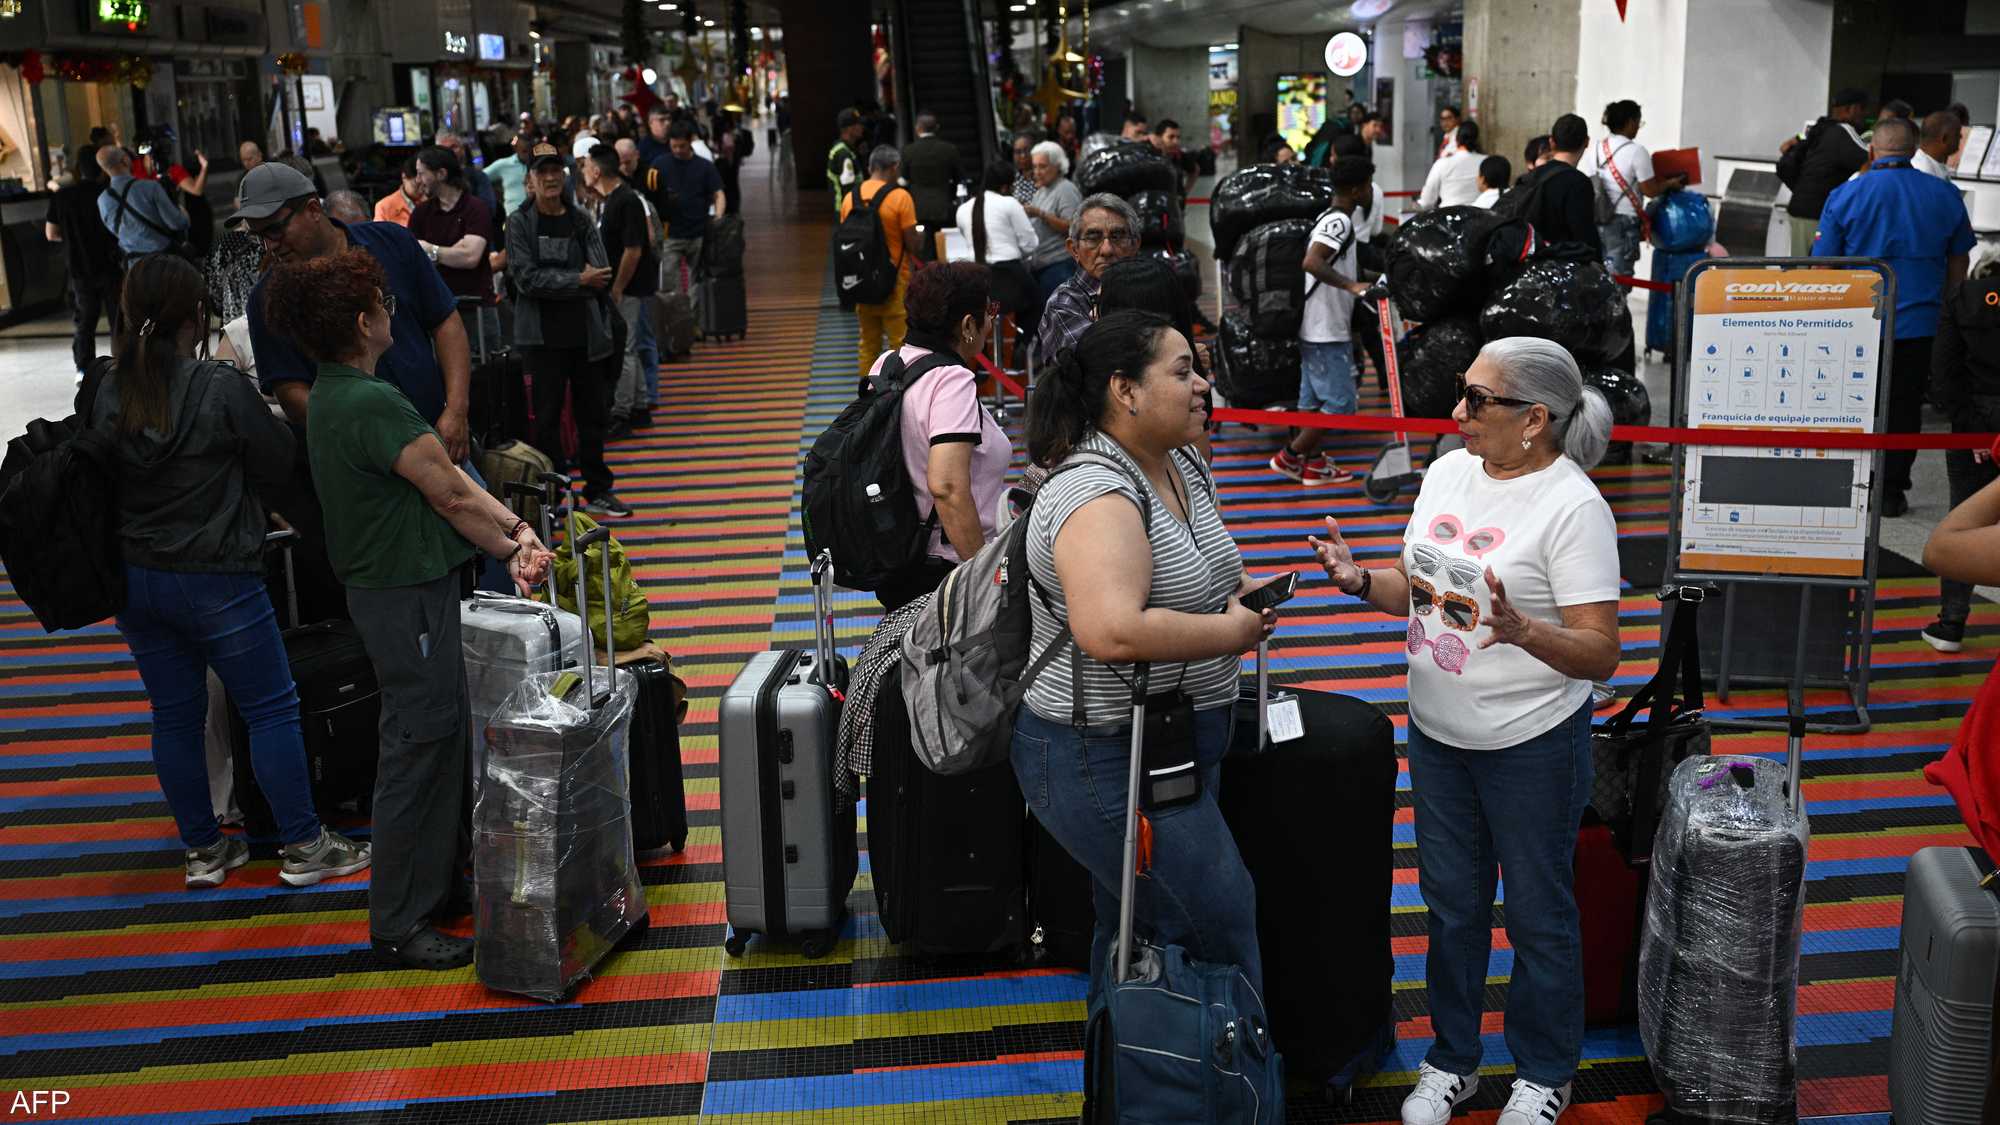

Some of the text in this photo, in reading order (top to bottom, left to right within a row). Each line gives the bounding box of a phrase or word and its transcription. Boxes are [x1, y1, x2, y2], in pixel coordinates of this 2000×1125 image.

[1722, 318, 1854, 329] Elementos No Permitidos
[1702, 412, 1862, 424] Franquicia de equipaje permitido
